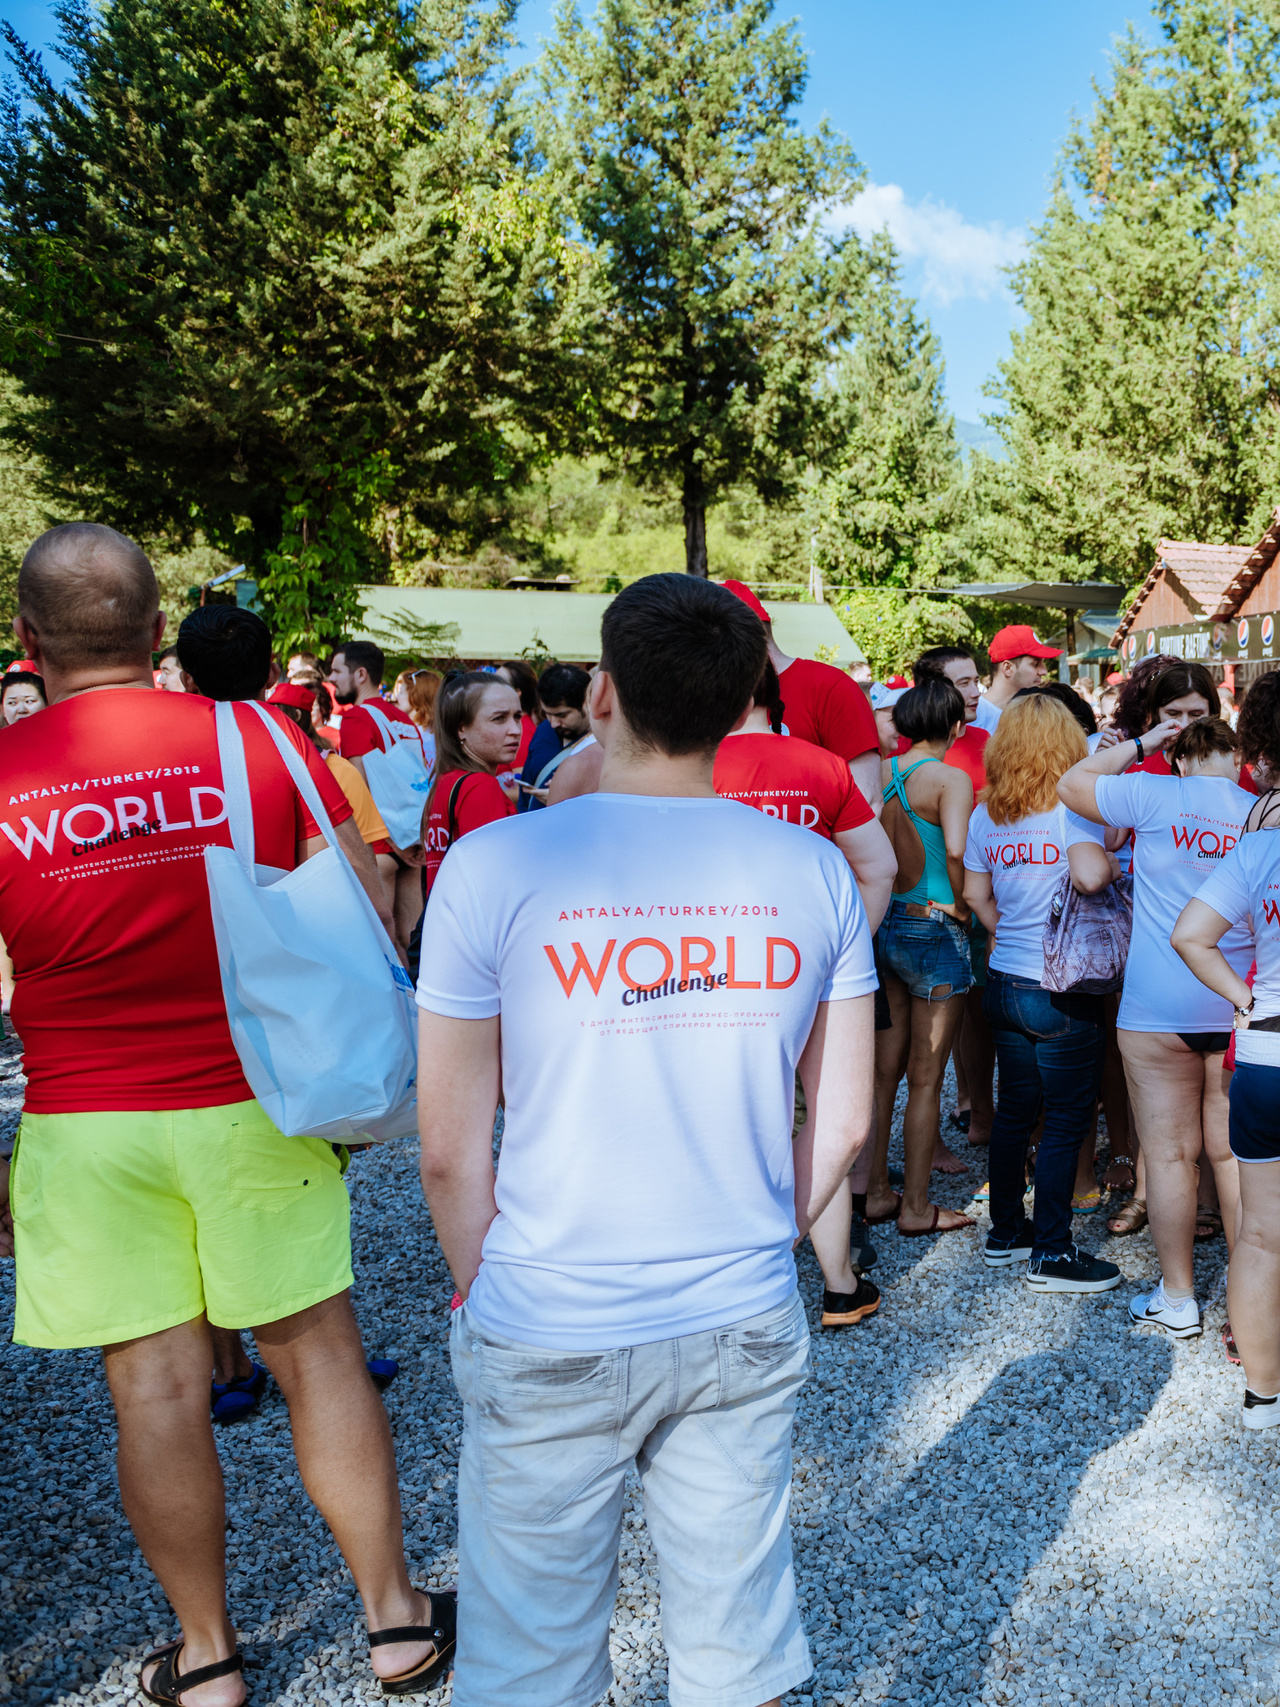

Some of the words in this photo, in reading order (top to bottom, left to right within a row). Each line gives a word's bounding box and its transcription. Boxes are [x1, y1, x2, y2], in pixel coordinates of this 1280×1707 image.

[8, 765, 201, 806] ANTALYA/TURKEY/2018
[0, 786, 229, 861] WORLD
[71, 818, 162, 857] Challenge
[49, 867, 71, 877] ДНЕЙ
[73, 855, 134, 871] ИНТЕНСИВНОЙ
[984, 842, 1060, 867] WORLD
[58, 875, 68, 884] ОТ
[71, 867, 110, 880] ВЕДУЩИХ
[113, 859, 157, 871] СПИКЕРОВ
[558, 905, 779, 922] ANTALYA/TURKEY/2018
[543, 936, 801, 1000] WORLD
[621, 972, 729, 1006] Challenge
[590, 1018, 615, 1028] ДНЕЙ
[621, 1012, 687, 1024] ИНТЕНСИВНОЙ
[692, 1011, 781, 1019] БИЗНЕС-ПРОКАЧКИ
[600, 1029, 611, 1037] ОТ
[616, 1025, 659, 1035] ВЕДУЩИХ
[663, 1022, 712, 1030] СПИКЕРОВ
